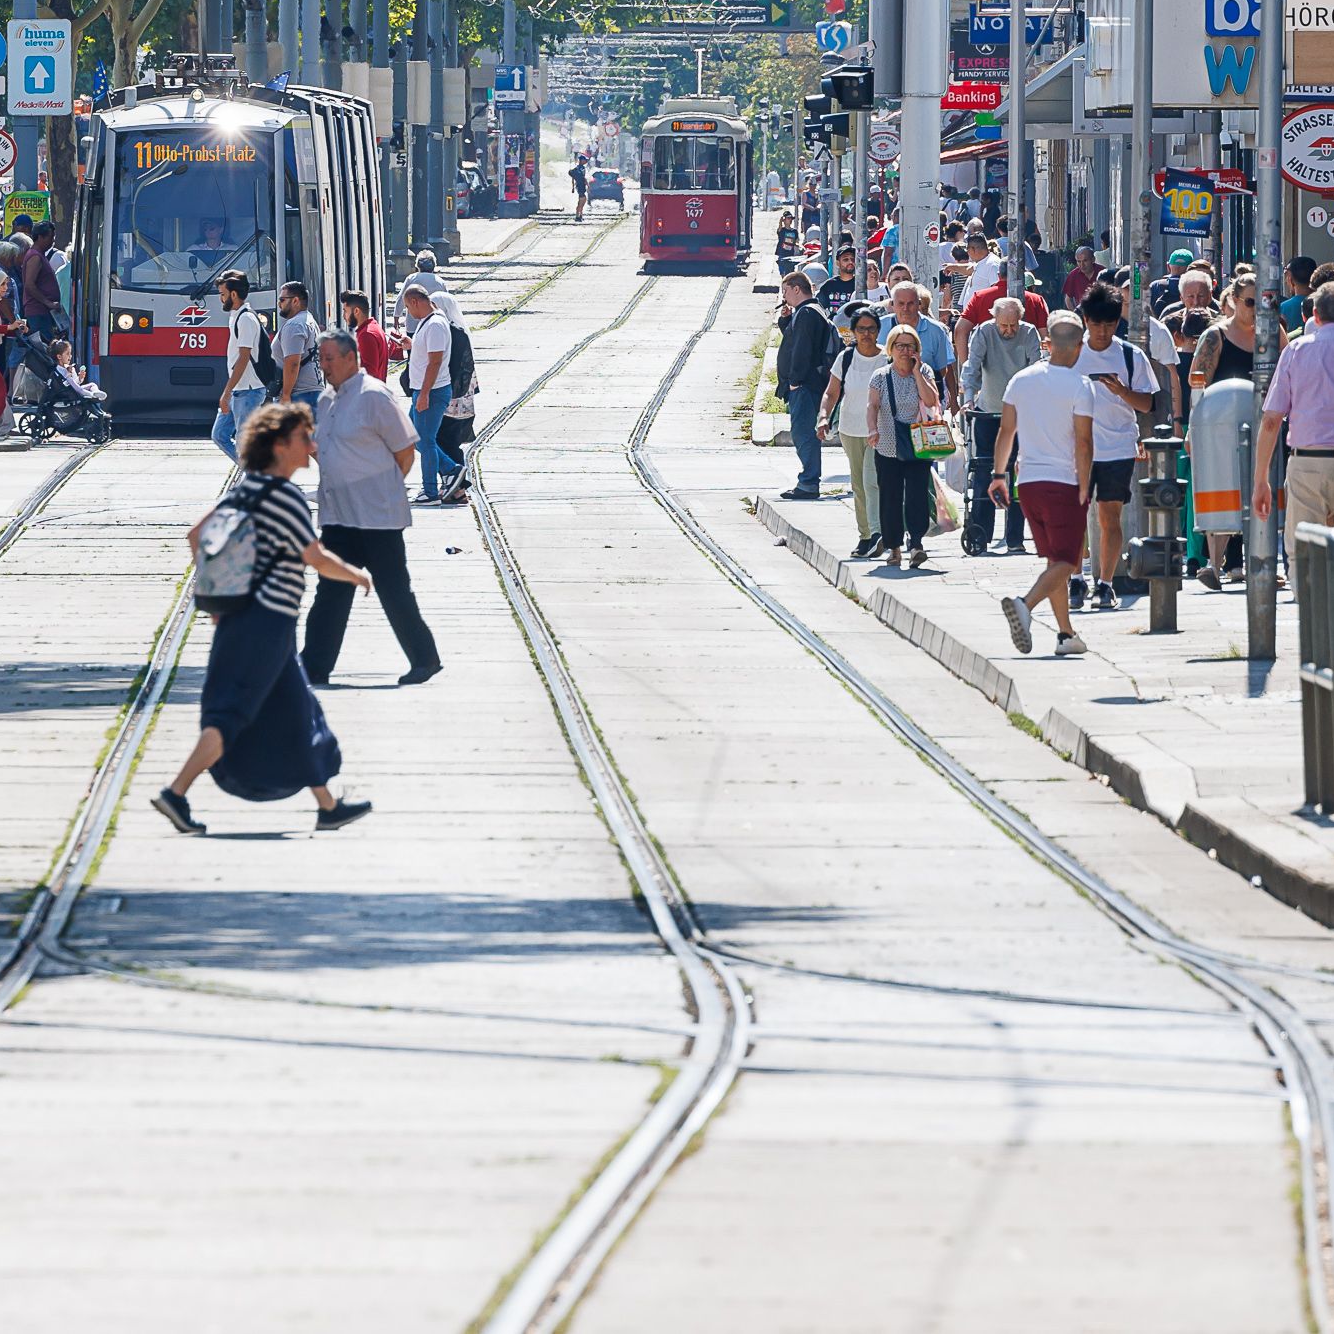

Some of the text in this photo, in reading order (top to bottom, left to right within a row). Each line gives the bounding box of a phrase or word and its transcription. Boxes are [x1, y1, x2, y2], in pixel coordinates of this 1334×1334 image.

[24, 28, 65, 39] huma
[947, 91, 996, 105] Banking
[134, 141, 256, 169] 11 Otto-Probst-Platz
[1164, 188, 1213, 214] 100
[1310, 212, 1324, 222] 11
[1163, 226, 1207, 236] EUROMILLIONEN
[179, 333, 207, 349] 769
